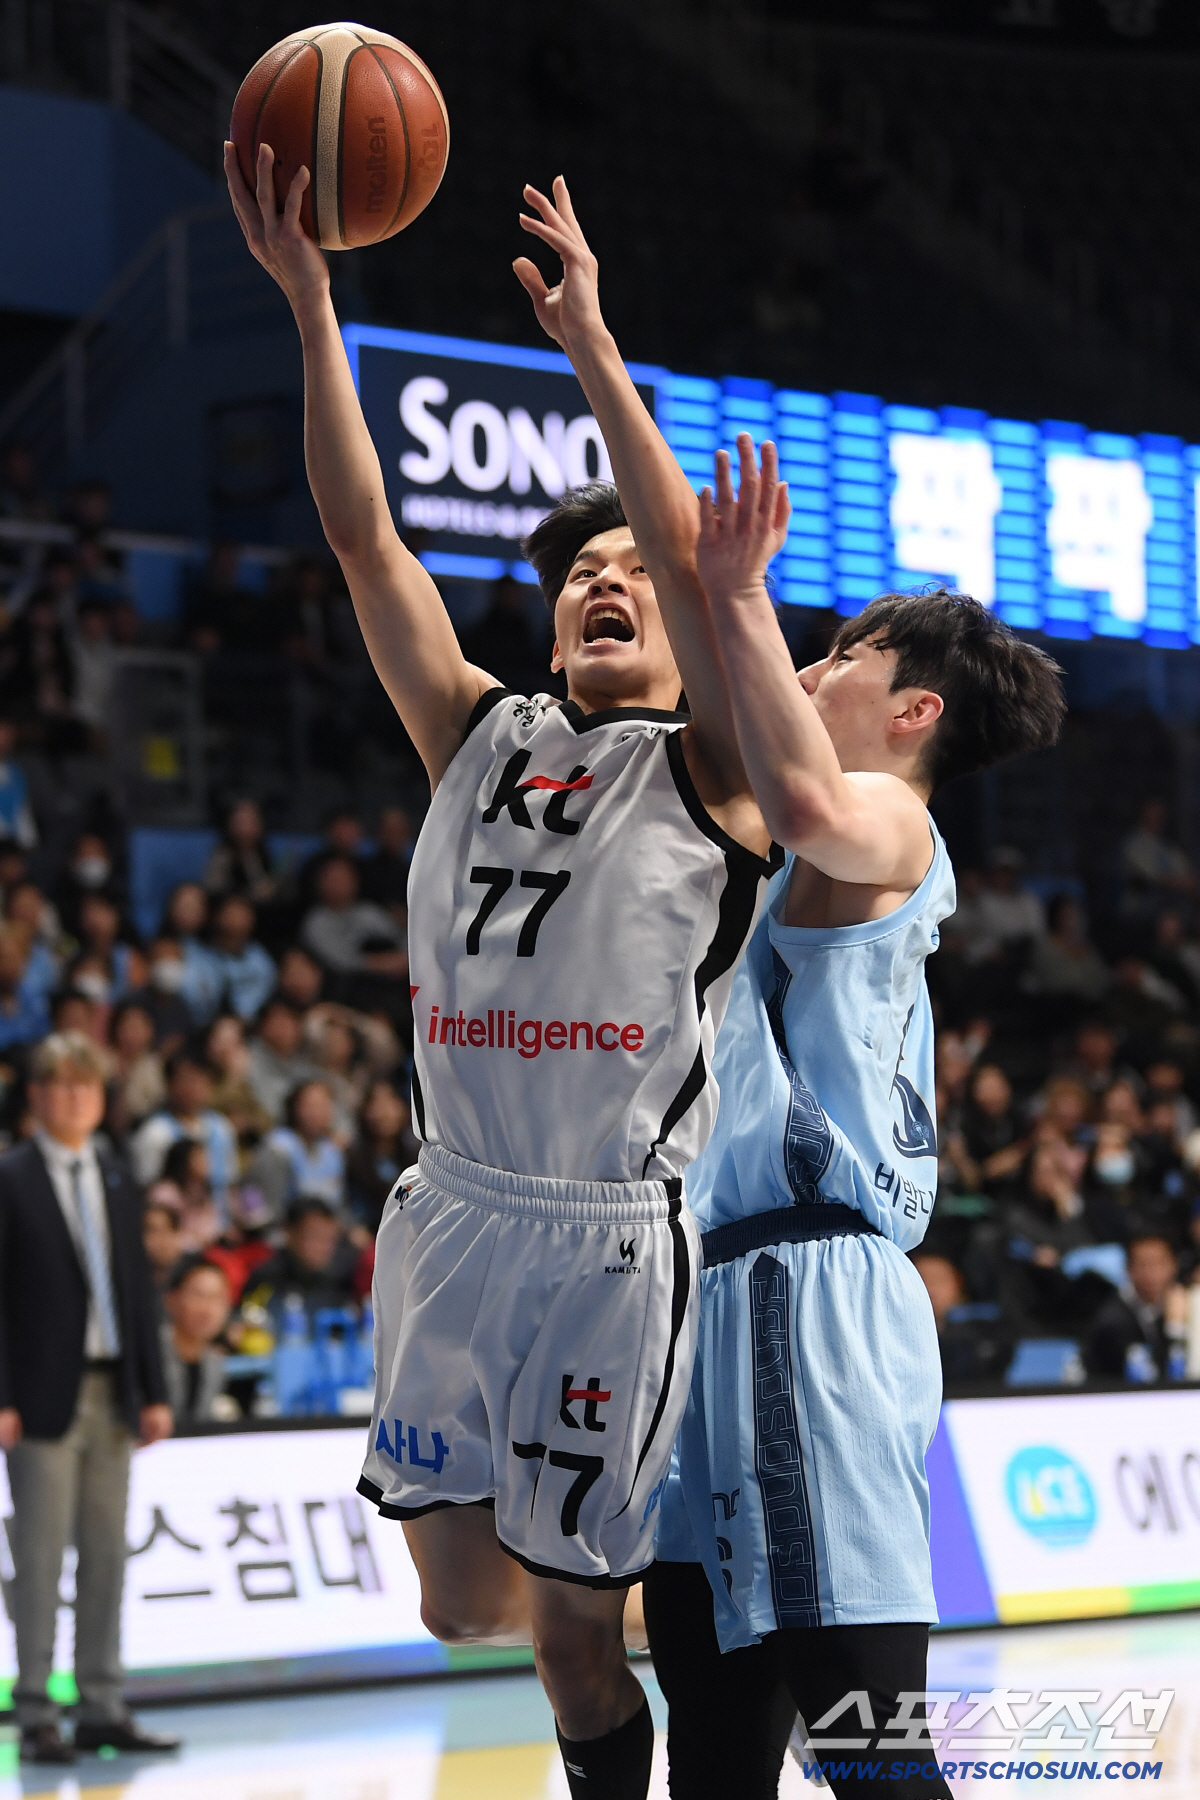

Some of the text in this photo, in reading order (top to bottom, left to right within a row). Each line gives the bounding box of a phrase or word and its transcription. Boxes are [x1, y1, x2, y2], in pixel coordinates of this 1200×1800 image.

[365, 115, 388, 214] molten
[399, 376, 614, 500] SONO
[482, 748, 596, 835] kt
[465, 866, 572, 957] 77
[428, 1005, 645, 1059] intelligence
[375, 1418, 449, 1474] 사나
[554, 1374, 612, 1432] kt
[512, 1441, 604, 1536] 77
